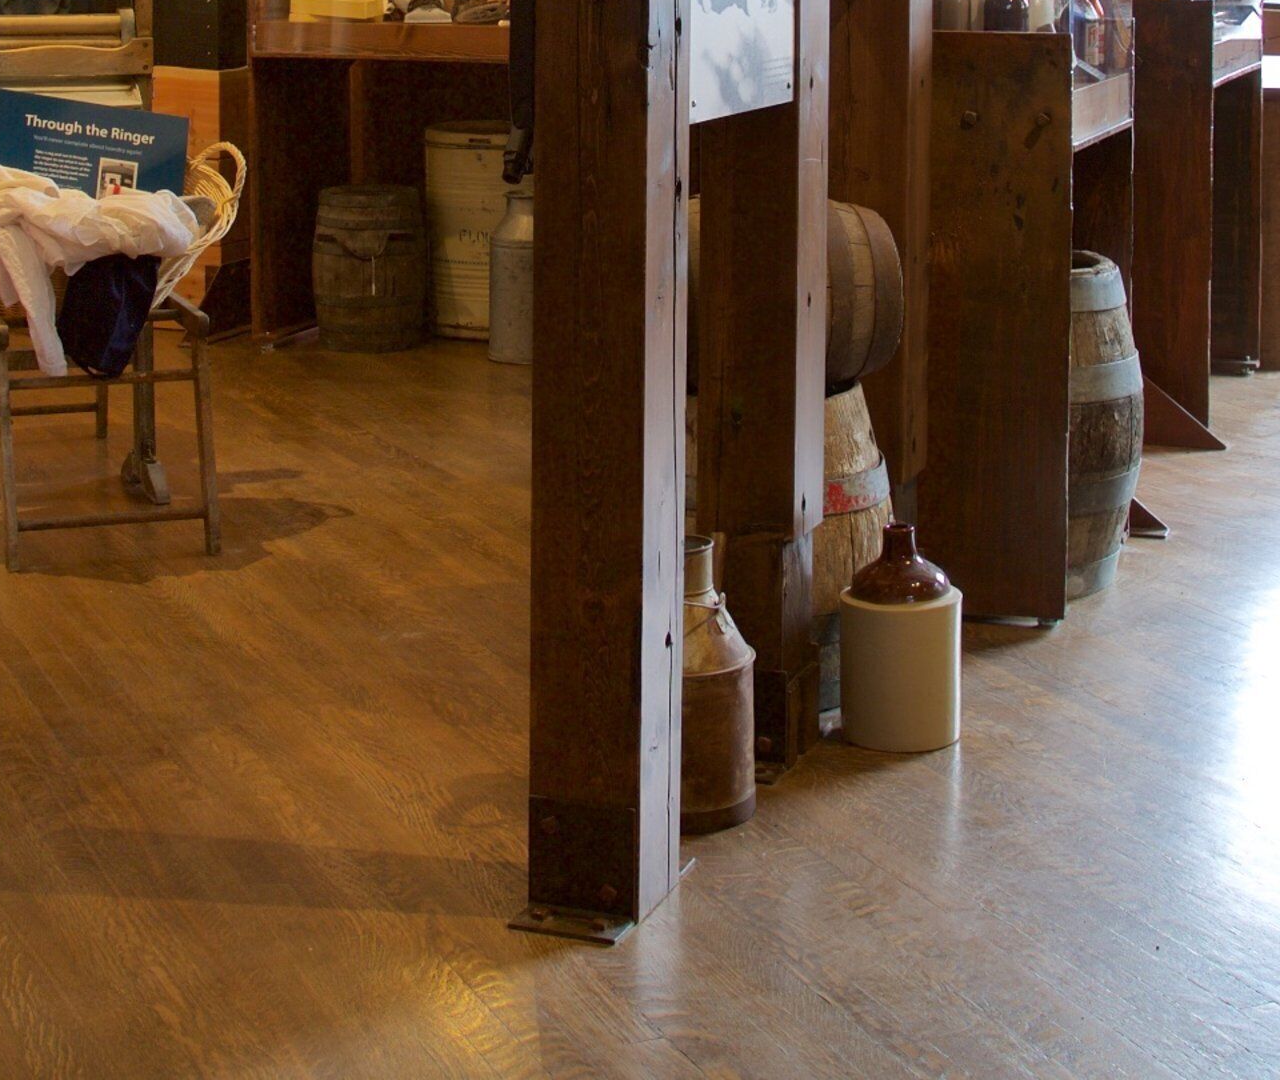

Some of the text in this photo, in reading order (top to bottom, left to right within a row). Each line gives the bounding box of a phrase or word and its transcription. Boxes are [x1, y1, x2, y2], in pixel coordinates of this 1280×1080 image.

[24, 113, 156, 147] Through the Ringer
[458, 228, 490, 244] FLO
